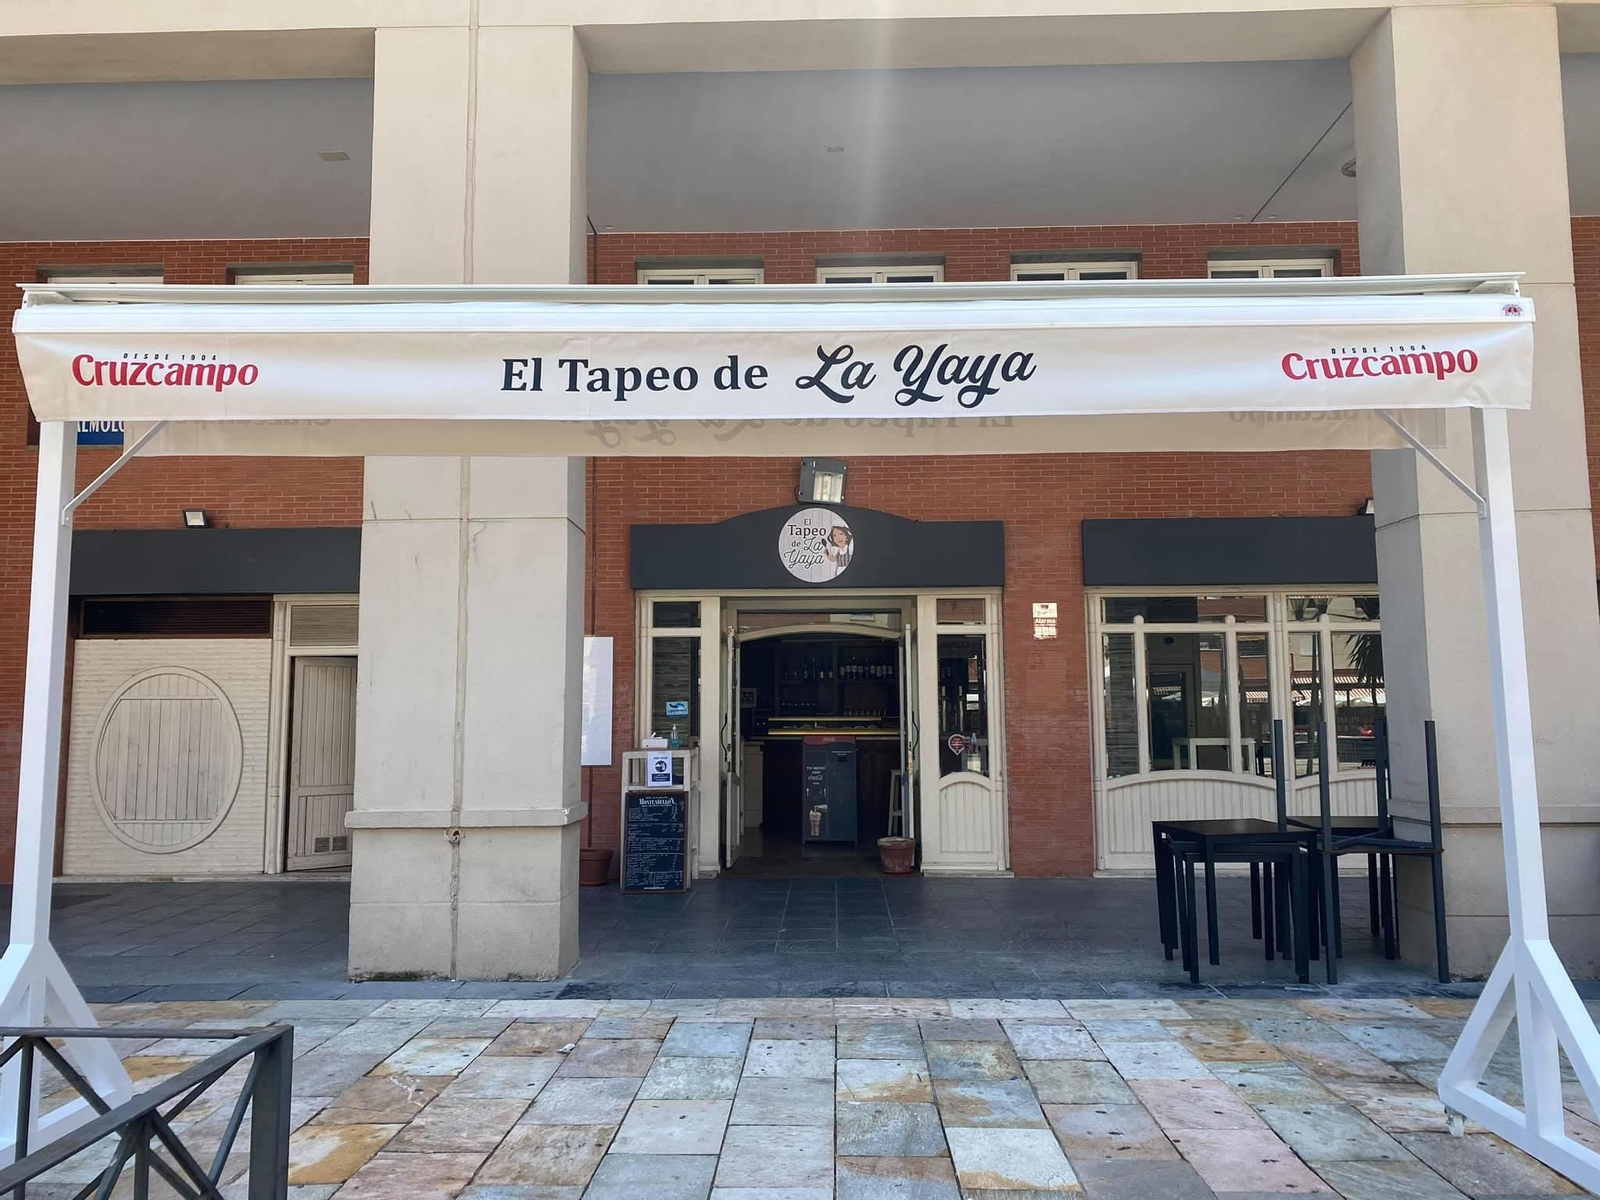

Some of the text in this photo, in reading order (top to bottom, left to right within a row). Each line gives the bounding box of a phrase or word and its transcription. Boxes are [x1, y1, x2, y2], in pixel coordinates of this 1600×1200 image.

[123, 352, 169, 361] DESDE
[1330, 344, 1428, 355] DESDE 1904
[72, 354, 259, 392] Cruzcampo
[1281, 348, 1479, 381] Cruzcampo
[501, 344, 1036, 409] El Tapeo de La Yaya
[787, 524, 826, 538] Tapeo
[804, 536, 824, 554] La
[784, 549, 826, 569] Yaya
